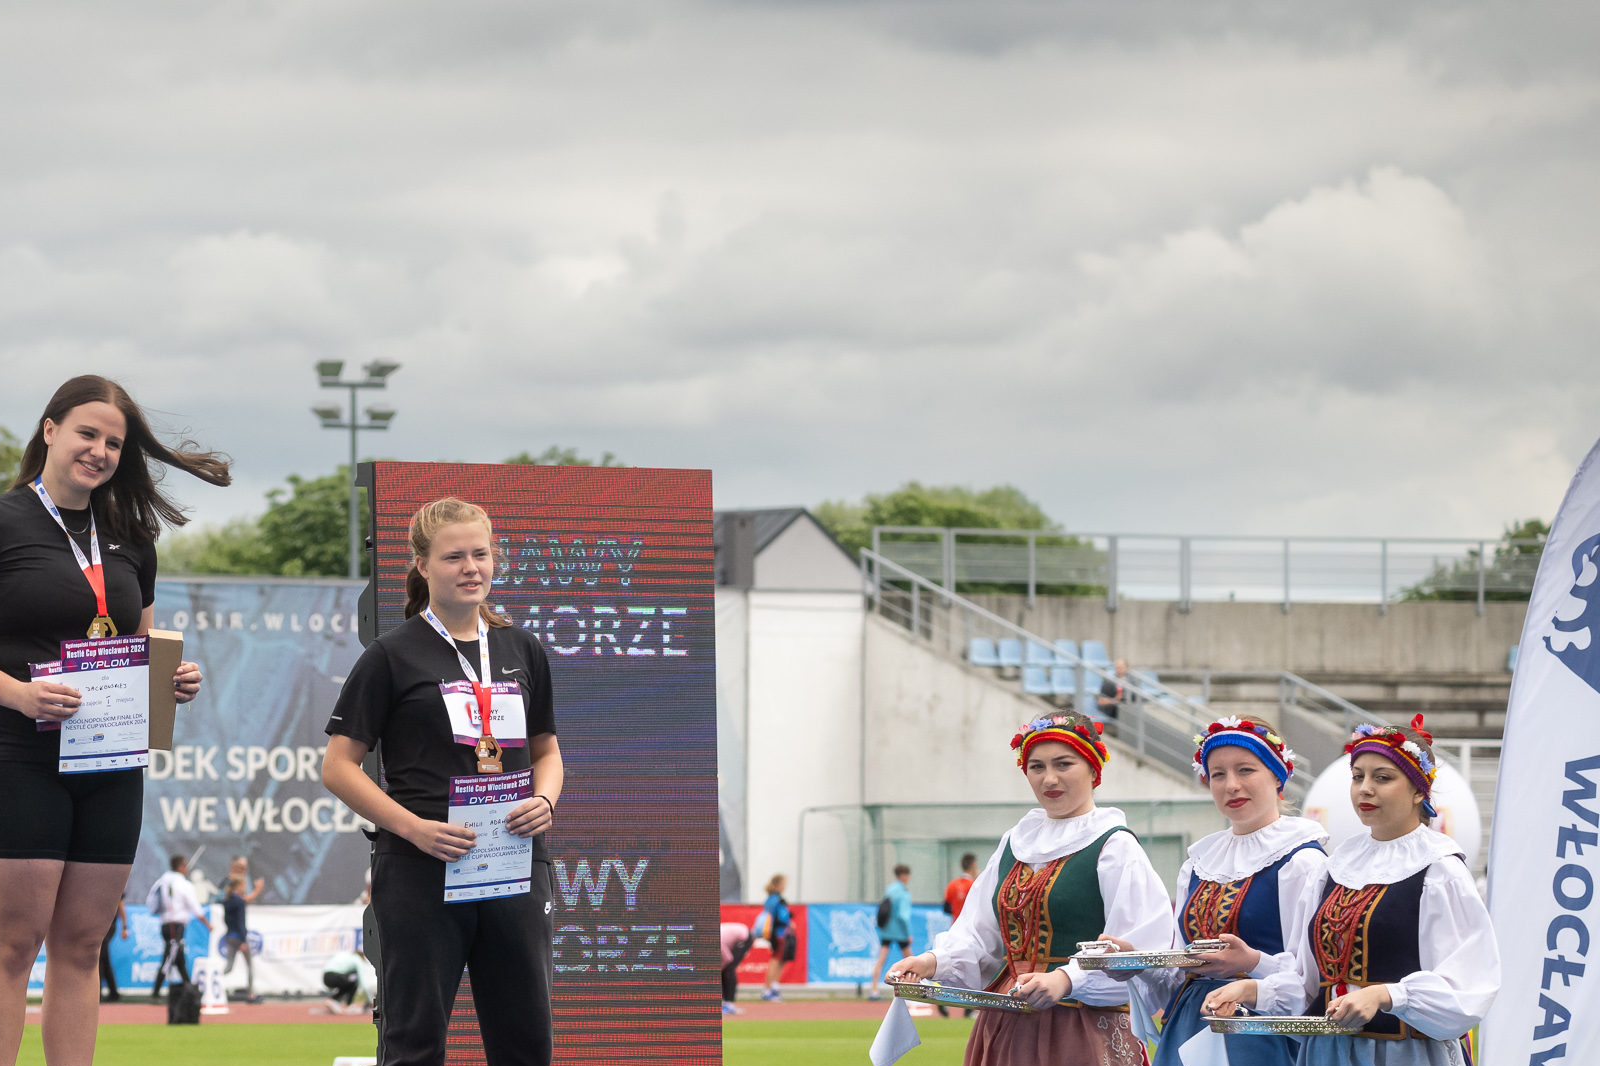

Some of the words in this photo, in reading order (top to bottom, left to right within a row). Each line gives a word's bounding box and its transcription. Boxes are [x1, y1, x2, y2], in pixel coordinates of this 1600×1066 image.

[494, 604, 688, 656] MORZE
[66, 649, 84, 659] Nestlé
[85, 648, 97, 658] Cup
[98, 646, 129, 656] Włocławek
[130, 644, 145, 653] 2024
[81, 658, 130, 670] DYPLOM
[475, 784, 486, 793] Cup
[487, 781, 517, 791] Włocławek
[518, 778, 530, 787] 2024
[469, 793, 518, 804] DYPLOM
[160, 797, 218, 832] WE
